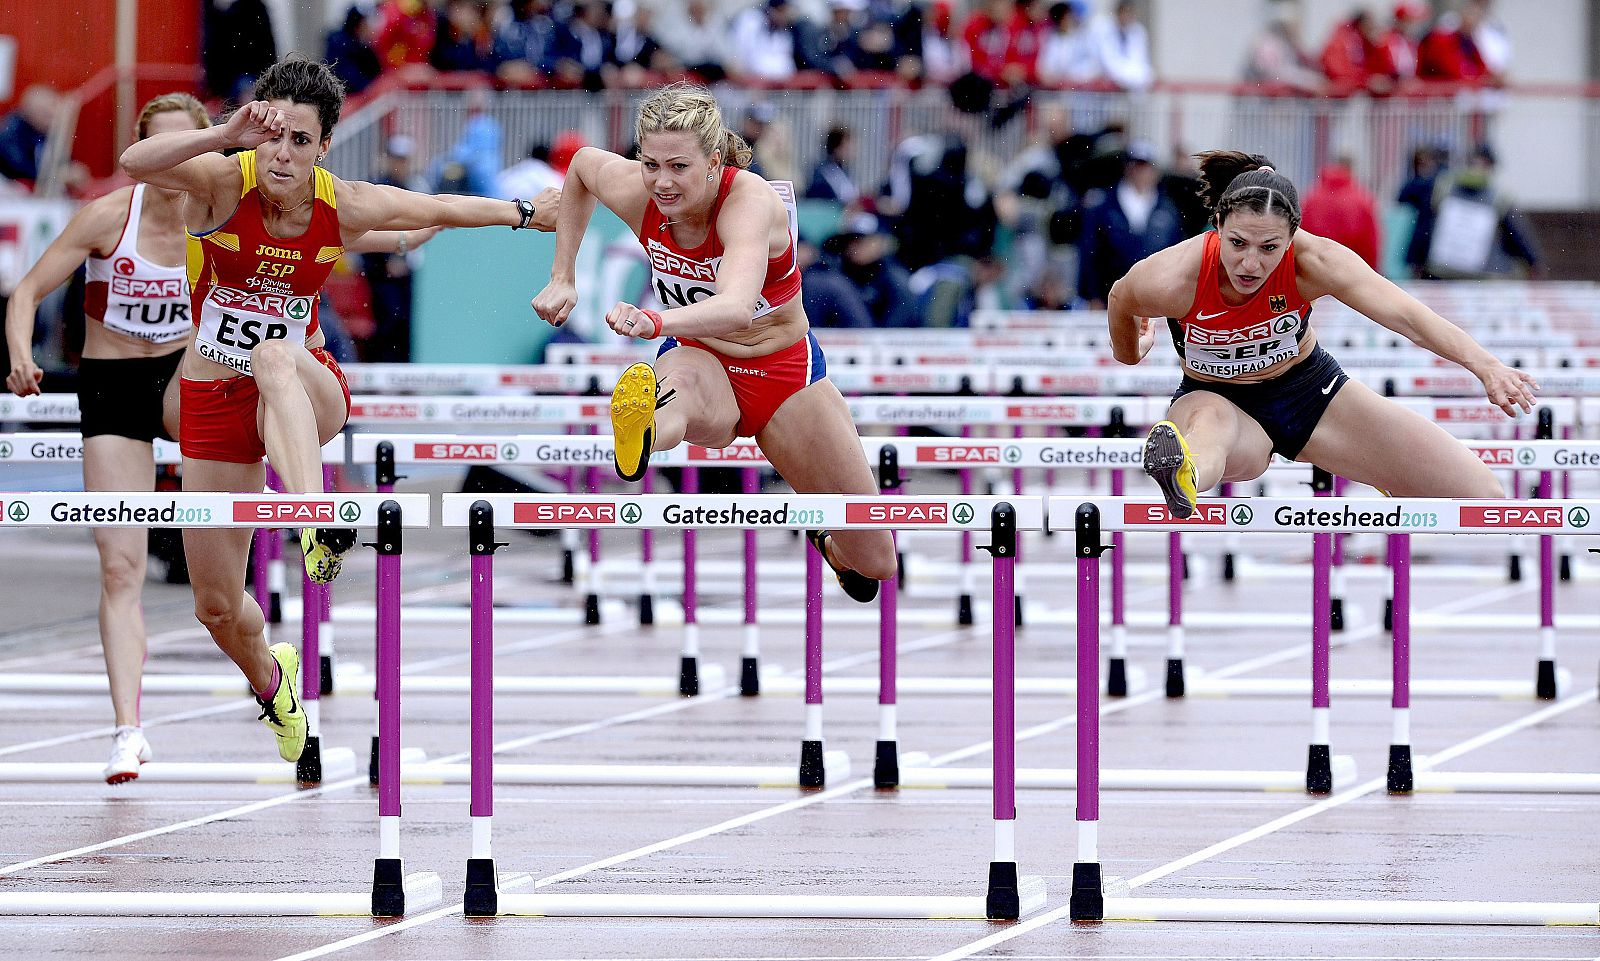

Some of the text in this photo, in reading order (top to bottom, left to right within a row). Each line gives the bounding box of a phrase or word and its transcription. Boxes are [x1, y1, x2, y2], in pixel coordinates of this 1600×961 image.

[256, 261, 295, 277] ESP
[653, 252, 714, 280] SPAR
[113, 278, 181, 297] SPAR
[261, 285, 294, 295] Pastora
[262, 278, 291, 289] Divina
[119, 303, 189, 324] TUR
[216, 313, 288, 350] ESP
[1190, 326, 1269, 344] SPAR
[200, 345, 251, 372] GATESHE
[728, 366, 759, 376] CRAFT
[432, 444, 496, 459] SPAR
[934, 447, 998, 461] SPAR
[257, 504, 333, 519] SPAR
[537, 506, 614, 521] SPAR
[869, 506, 946, 521] SPAR
[1483, 509, 1562, 524] SPAR
